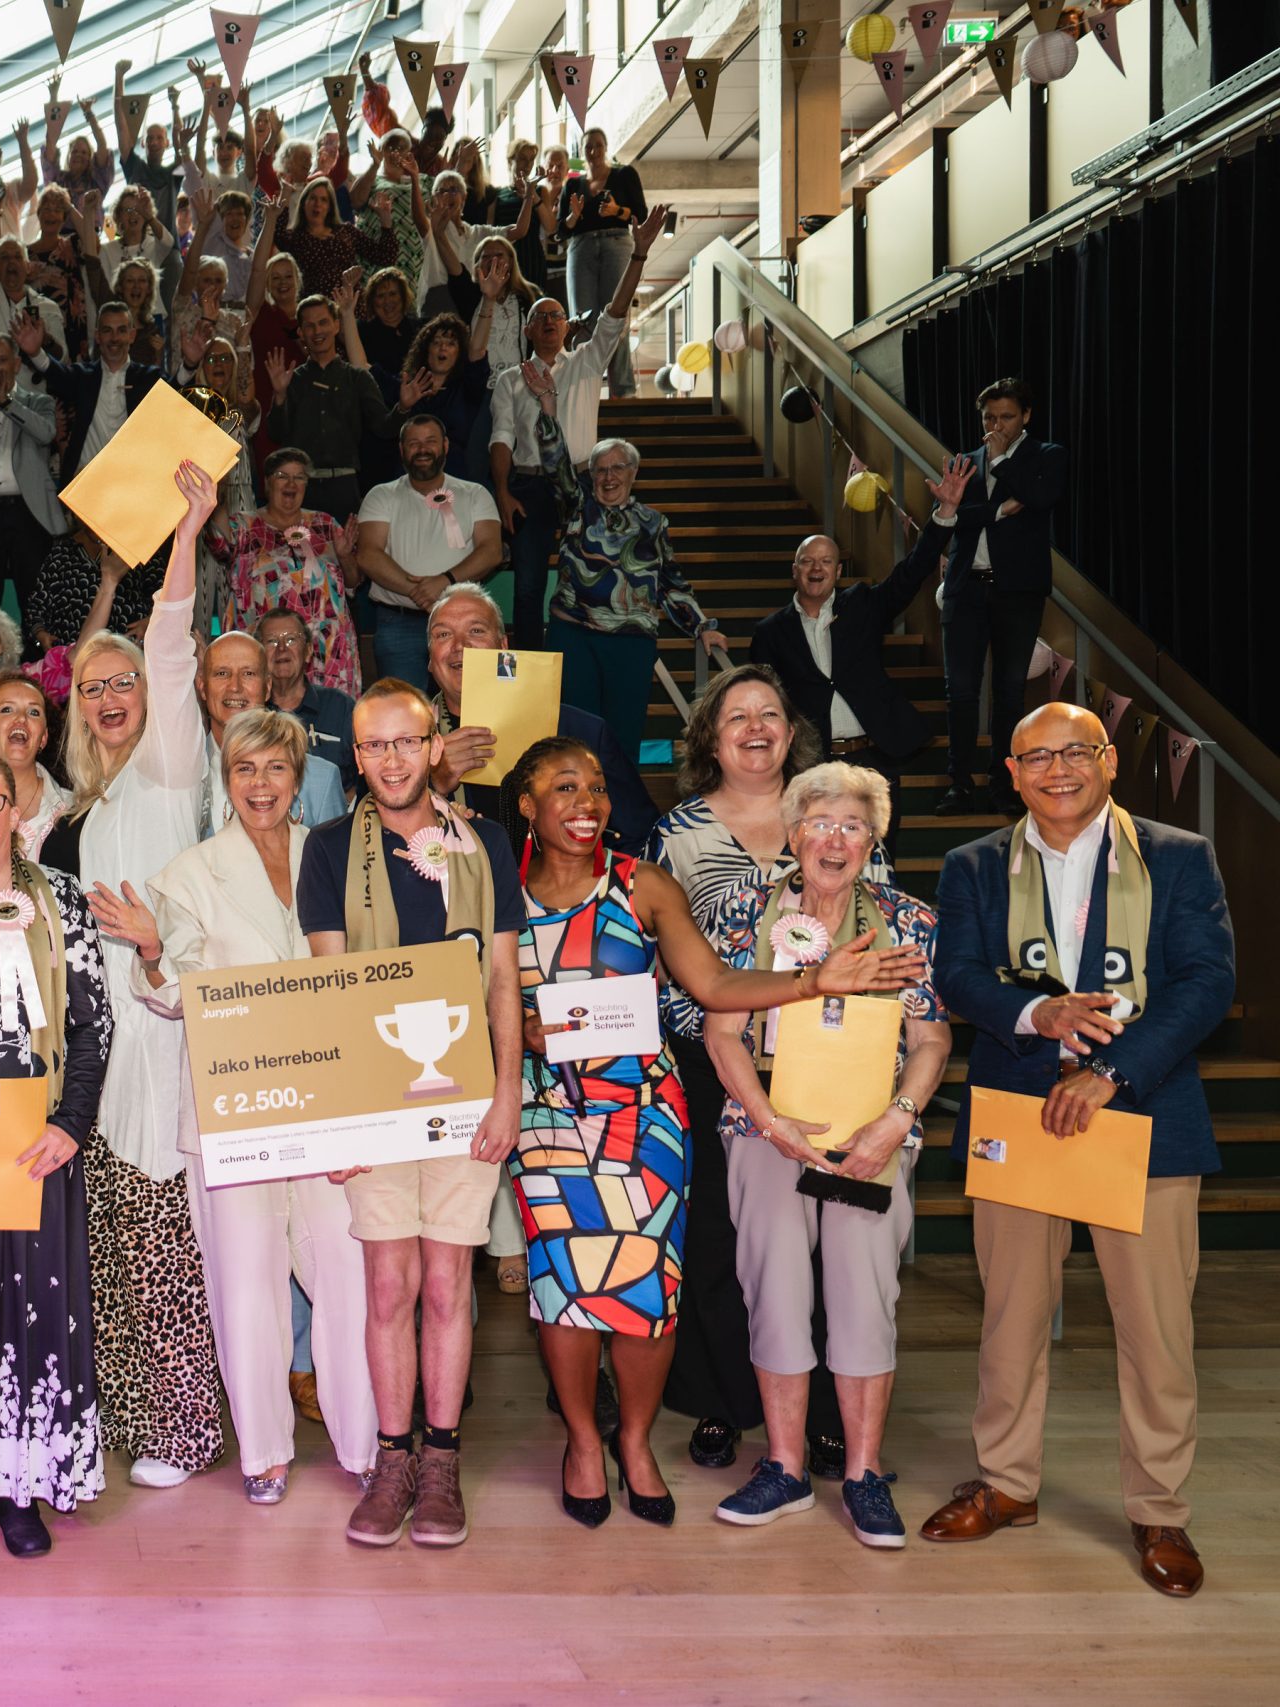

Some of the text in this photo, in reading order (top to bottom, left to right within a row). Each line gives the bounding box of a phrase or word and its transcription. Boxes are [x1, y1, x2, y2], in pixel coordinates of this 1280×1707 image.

[196, 960, 415, 1004] Taalheldenprijs 2025
[201, 1004, 250, 1020] Juryprijs
[593, 1013, 621, 1021] Lezen
[594, 1021, 635, 1030] Schrijven
[208, 1046, 342, 1076] Jako Herrebout
[213, 1086, 315, 1116] € 2.500,-
[450, 1122, 475, 1131] Lezen
[451, 1130, 476, 1140] Schrij
